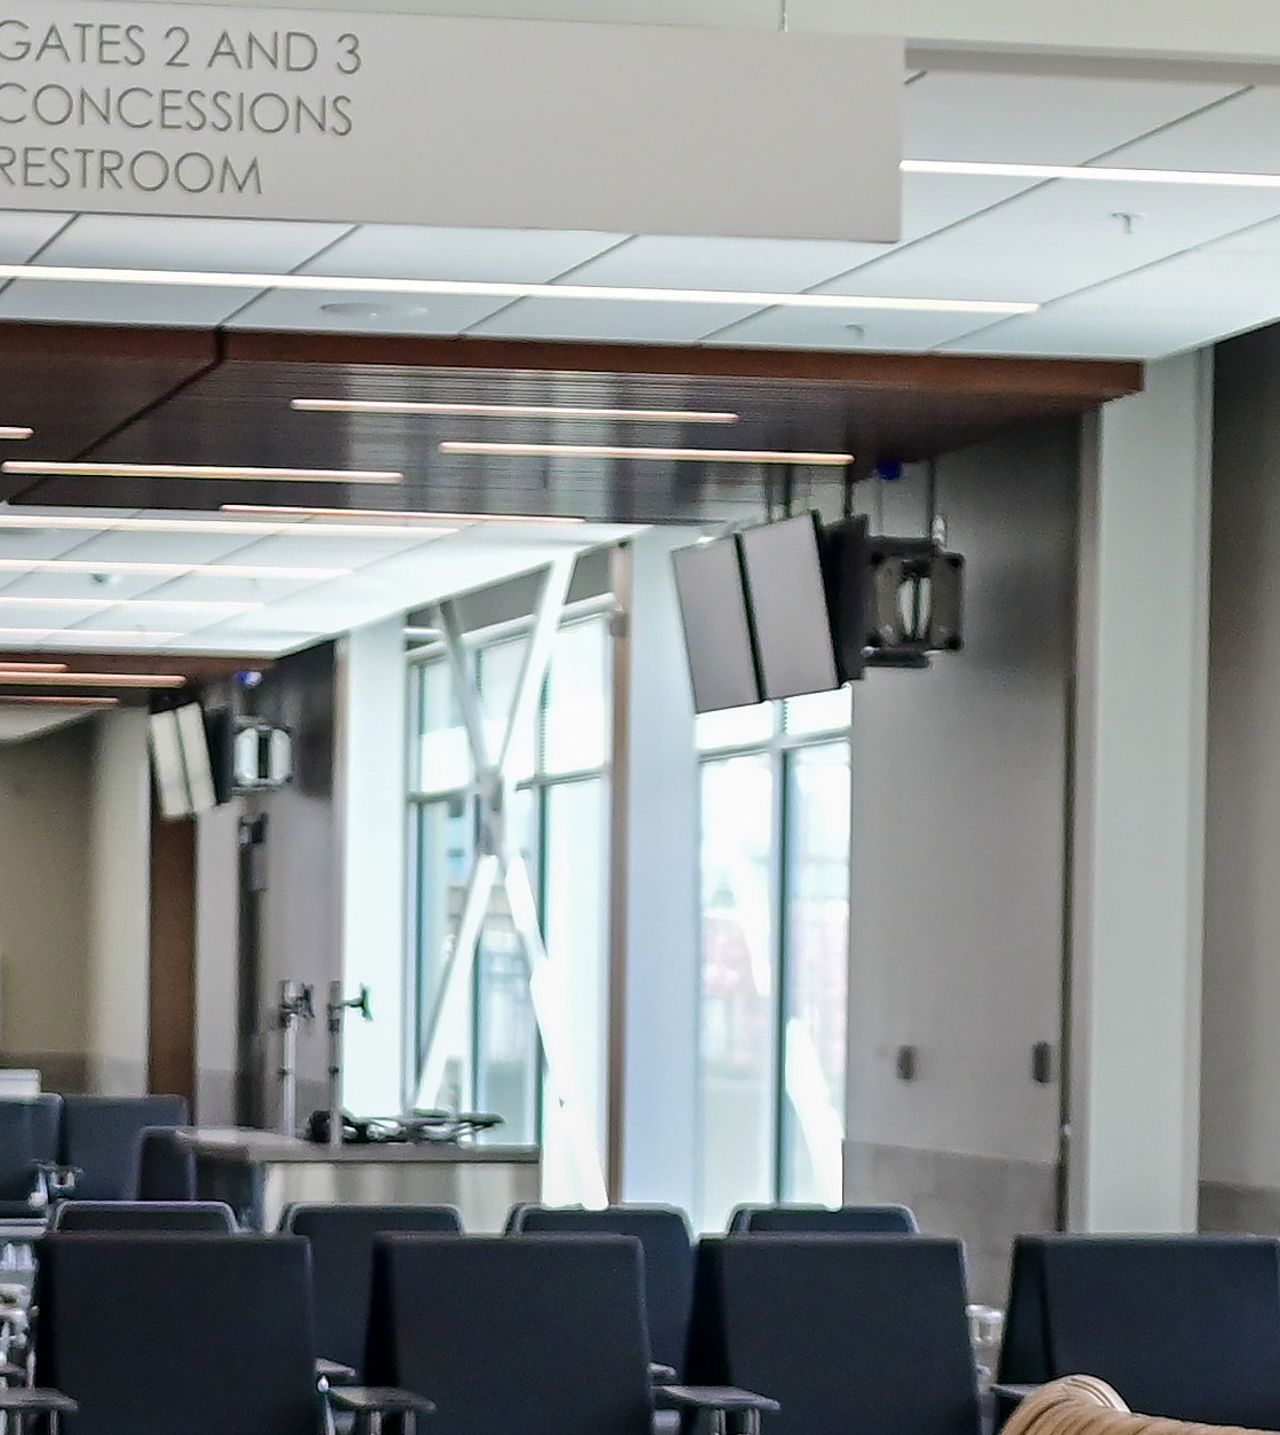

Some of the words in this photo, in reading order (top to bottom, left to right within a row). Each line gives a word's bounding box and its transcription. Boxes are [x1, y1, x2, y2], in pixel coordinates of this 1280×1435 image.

[164, 25, 191, 68] 2
[206, 30, 319, 73] AND
[335, 32, 362, 75] 3
